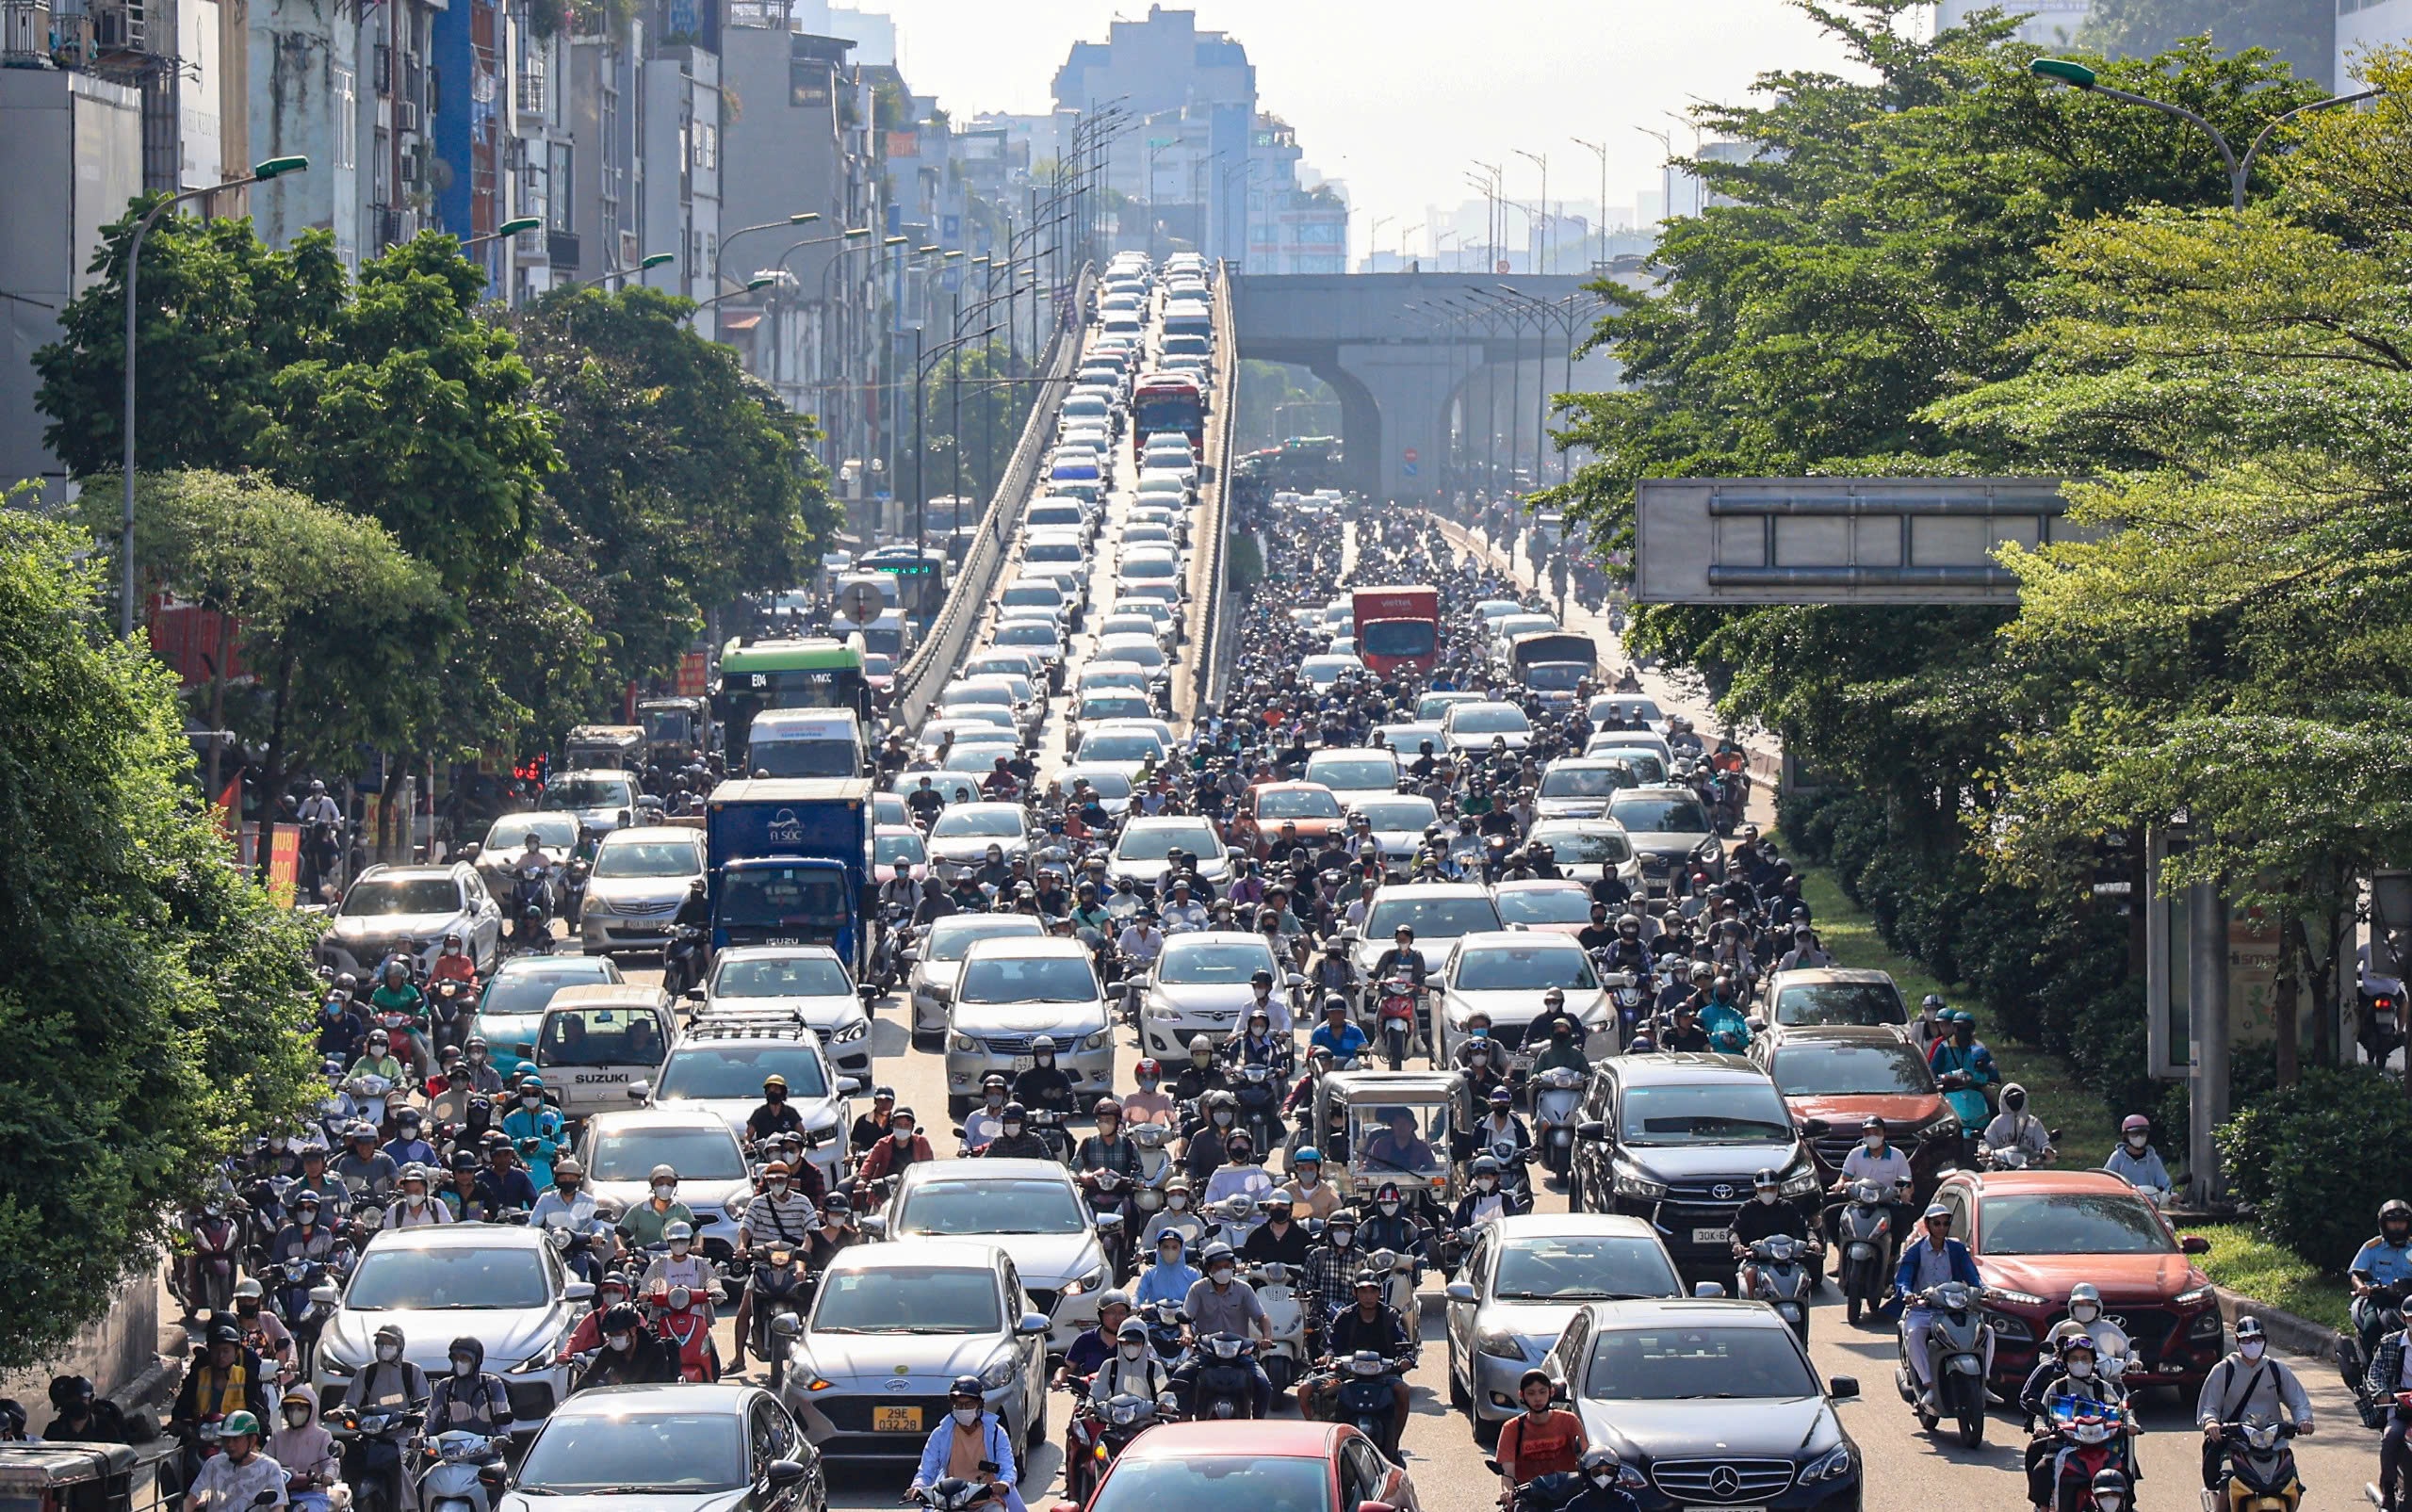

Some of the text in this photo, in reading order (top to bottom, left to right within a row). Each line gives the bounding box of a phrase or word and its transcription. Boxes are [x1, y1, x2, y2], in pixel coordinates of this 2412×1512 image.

[752, 674, 767, 688] E04
[766, 937, 799, 946] ISUZU
[575, 1074, 628, 1083] SUZUKI
[1698, 1230, 1730, 1241] 30K-6
[888, 1408, 908, 1419] 29E
[878, 1420, 917, 1431] 032.28
